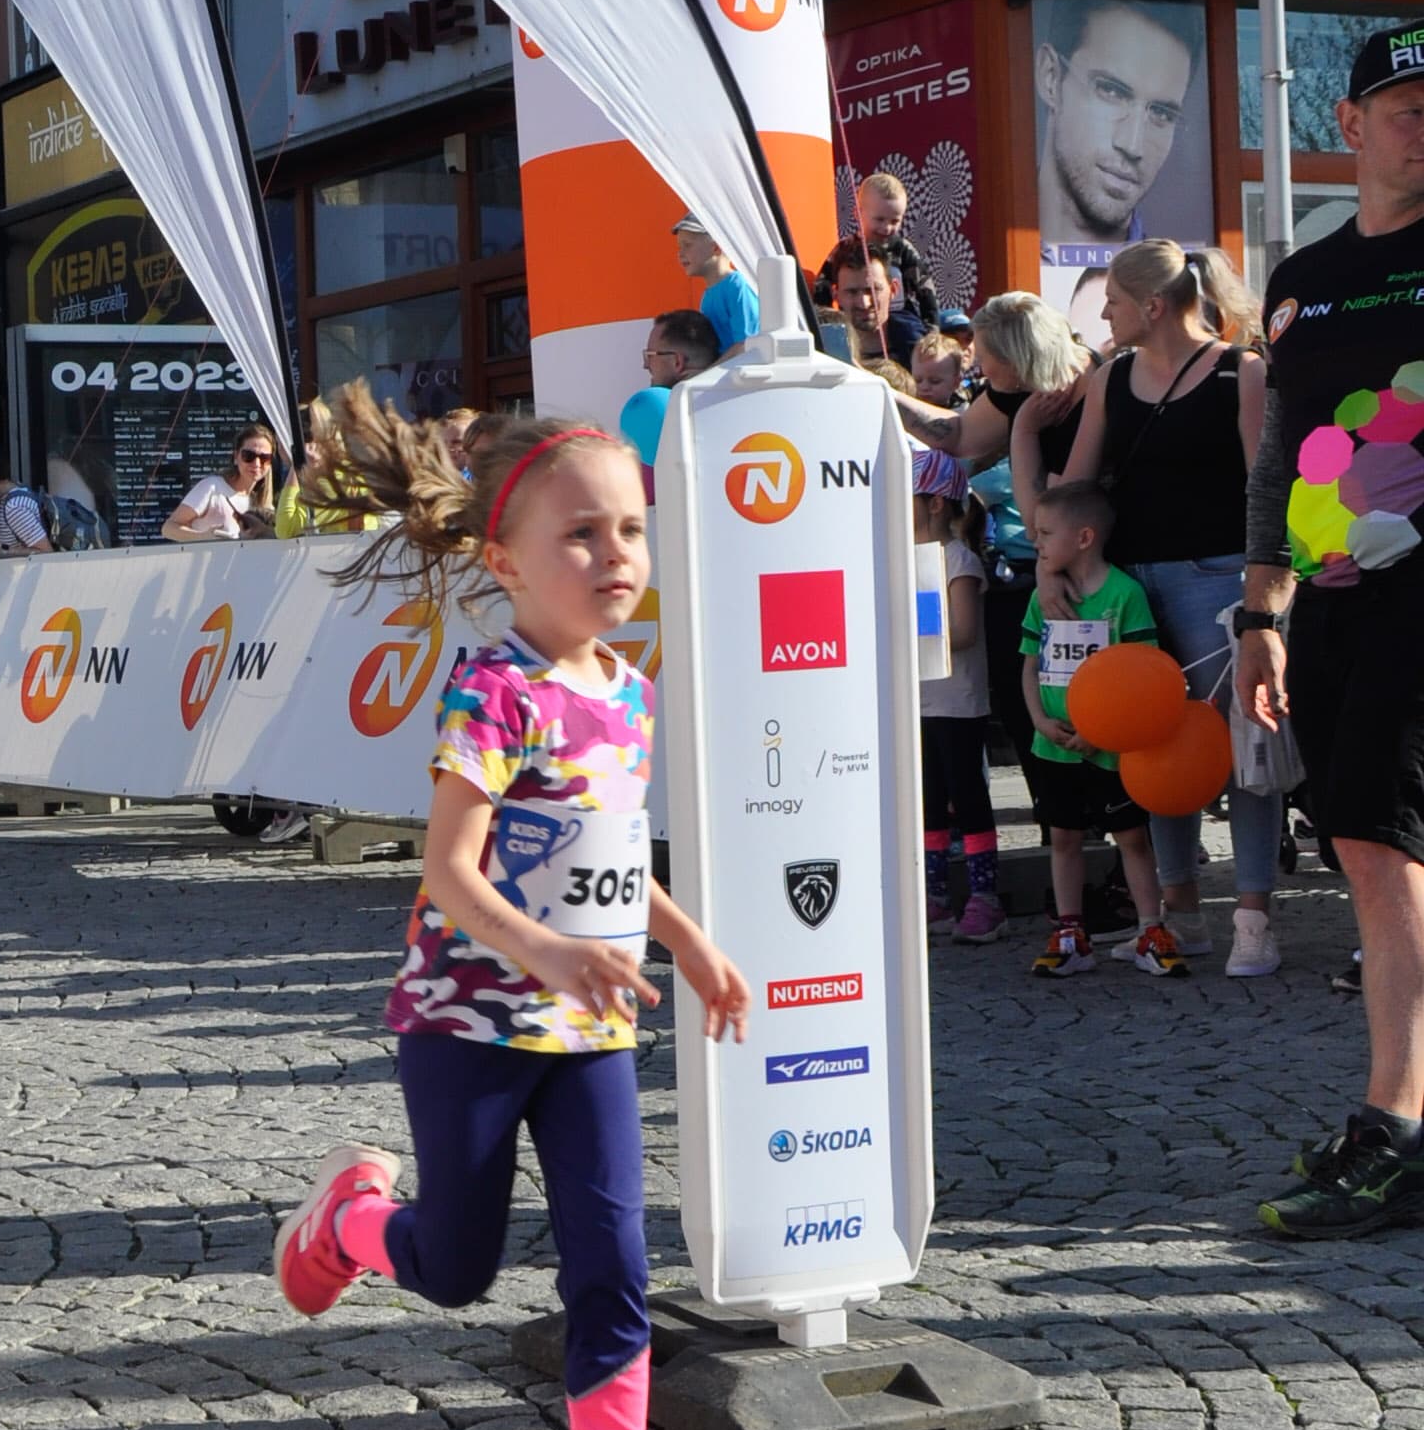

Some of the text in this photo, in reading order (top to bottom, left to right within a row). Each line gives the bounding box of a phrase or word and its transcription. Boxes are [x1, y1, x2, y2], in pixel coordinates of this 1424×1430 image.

[856, 44, 922, 72] OPTIKA
[1300, 303, 1333, 319] NN
[1342, 291, 1406, 312] NIGHT
[51, 361, 118, 392] 04
[130, 361, 252, 391] 2023
[820, 460, 870, 489] NN
[85, 646, 130, 684] NN
[227, 641, 278, 681] NN
[770, 641, 838, 663] AVON
[831, 751, 870, 763] Powered
[745, 798, 804, 815] innogy
[508, 821, 552, 841] KIDS
[506, 838, 545, 856] CUP
[788, 864, 836, 875] PEUGEOT
[561, 865, 645, 907] 3061
[772, 978, 859, 1004] NUTREND
[801, 1127, 872, 1155] ŠKODA
[784, 1215, 863, 1247] KPMG
